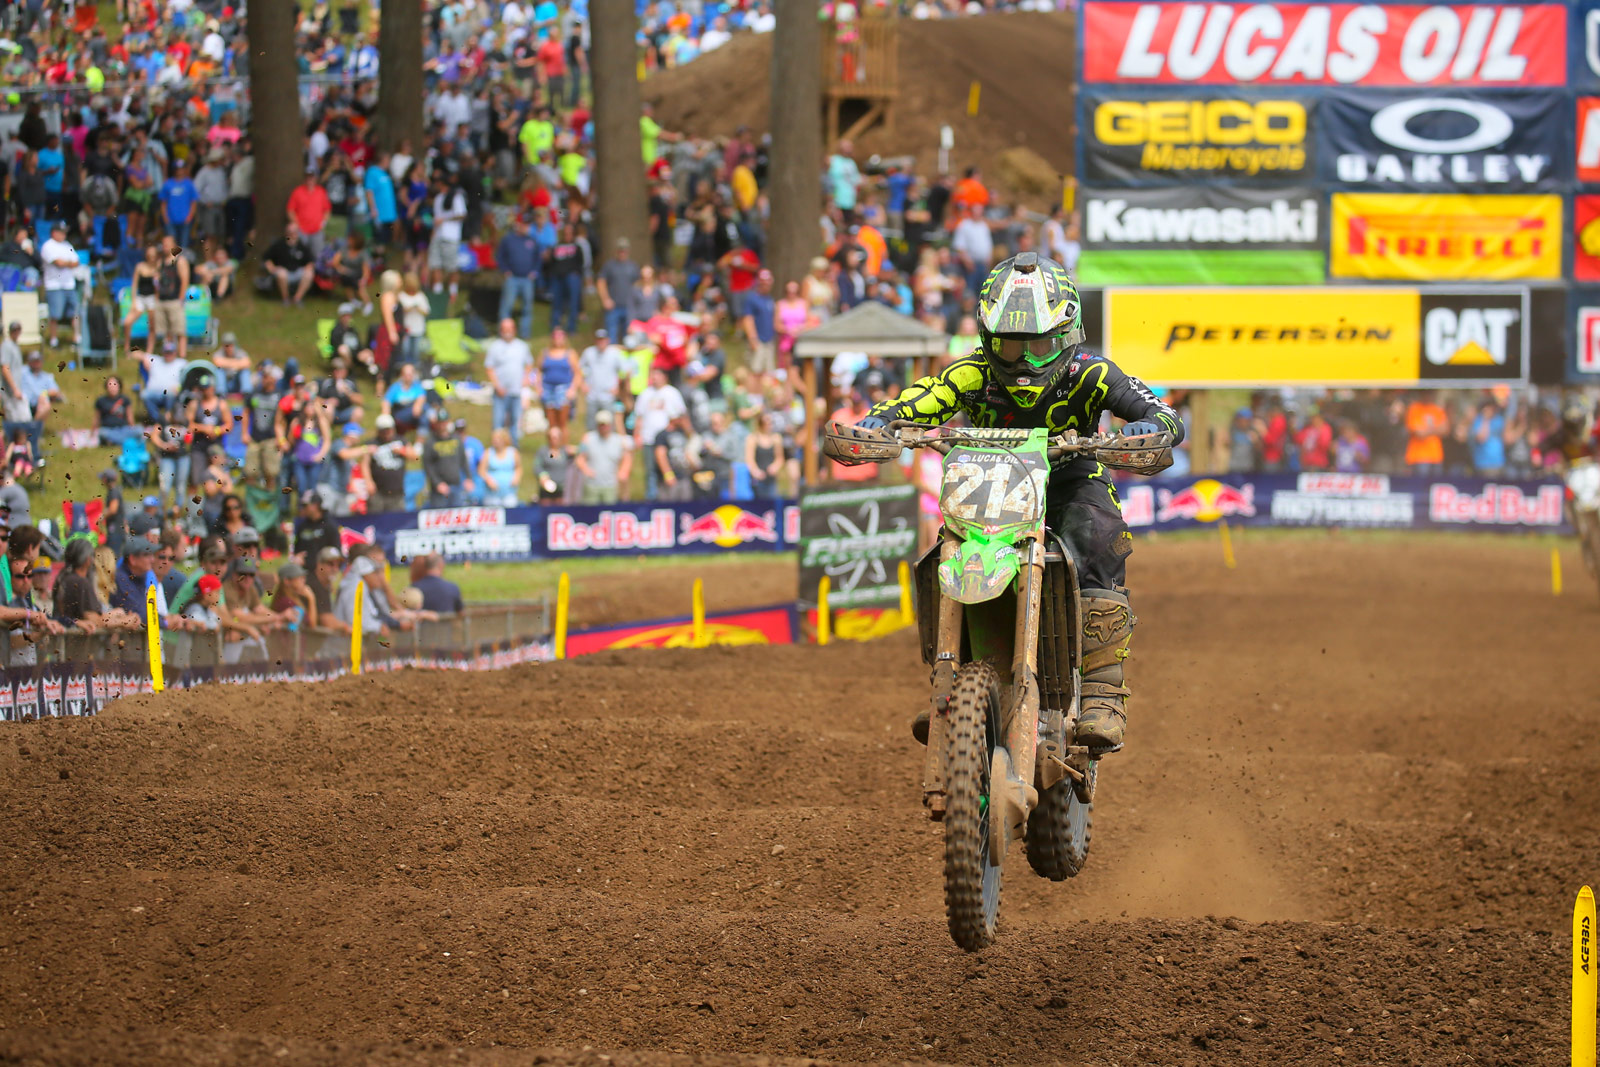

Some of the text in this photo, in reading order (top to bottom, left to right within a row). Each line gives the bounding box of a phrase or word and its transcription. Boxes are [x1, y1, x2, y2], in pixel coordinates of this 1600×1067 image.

[1116, 4, 1527, 83] LUCAS OIL
[1094, 100, 1306, 145] GEICO
[1141, 142, 1306, 176] Motorcycle
[1337, 154, 1547, 183] OAKLEY
[1087, 200, 1318, 242] Kawasaki
[1348, 216, 1545, 258] PIRELLI
[1165, 318, 1393, 353] PETERSON
[1425, 307, 1517, 365] CAT
[972, 454, 1002, 463] LUCAS
[1004, 456, 1019, 464] OIL
[944, 463, 1048, 521] 214
[1430, 483, 1563, 526] Red Bull
[548, 508, 676, 551] Red Bull
[1581, 915, 1590, 976] ACERBIS
